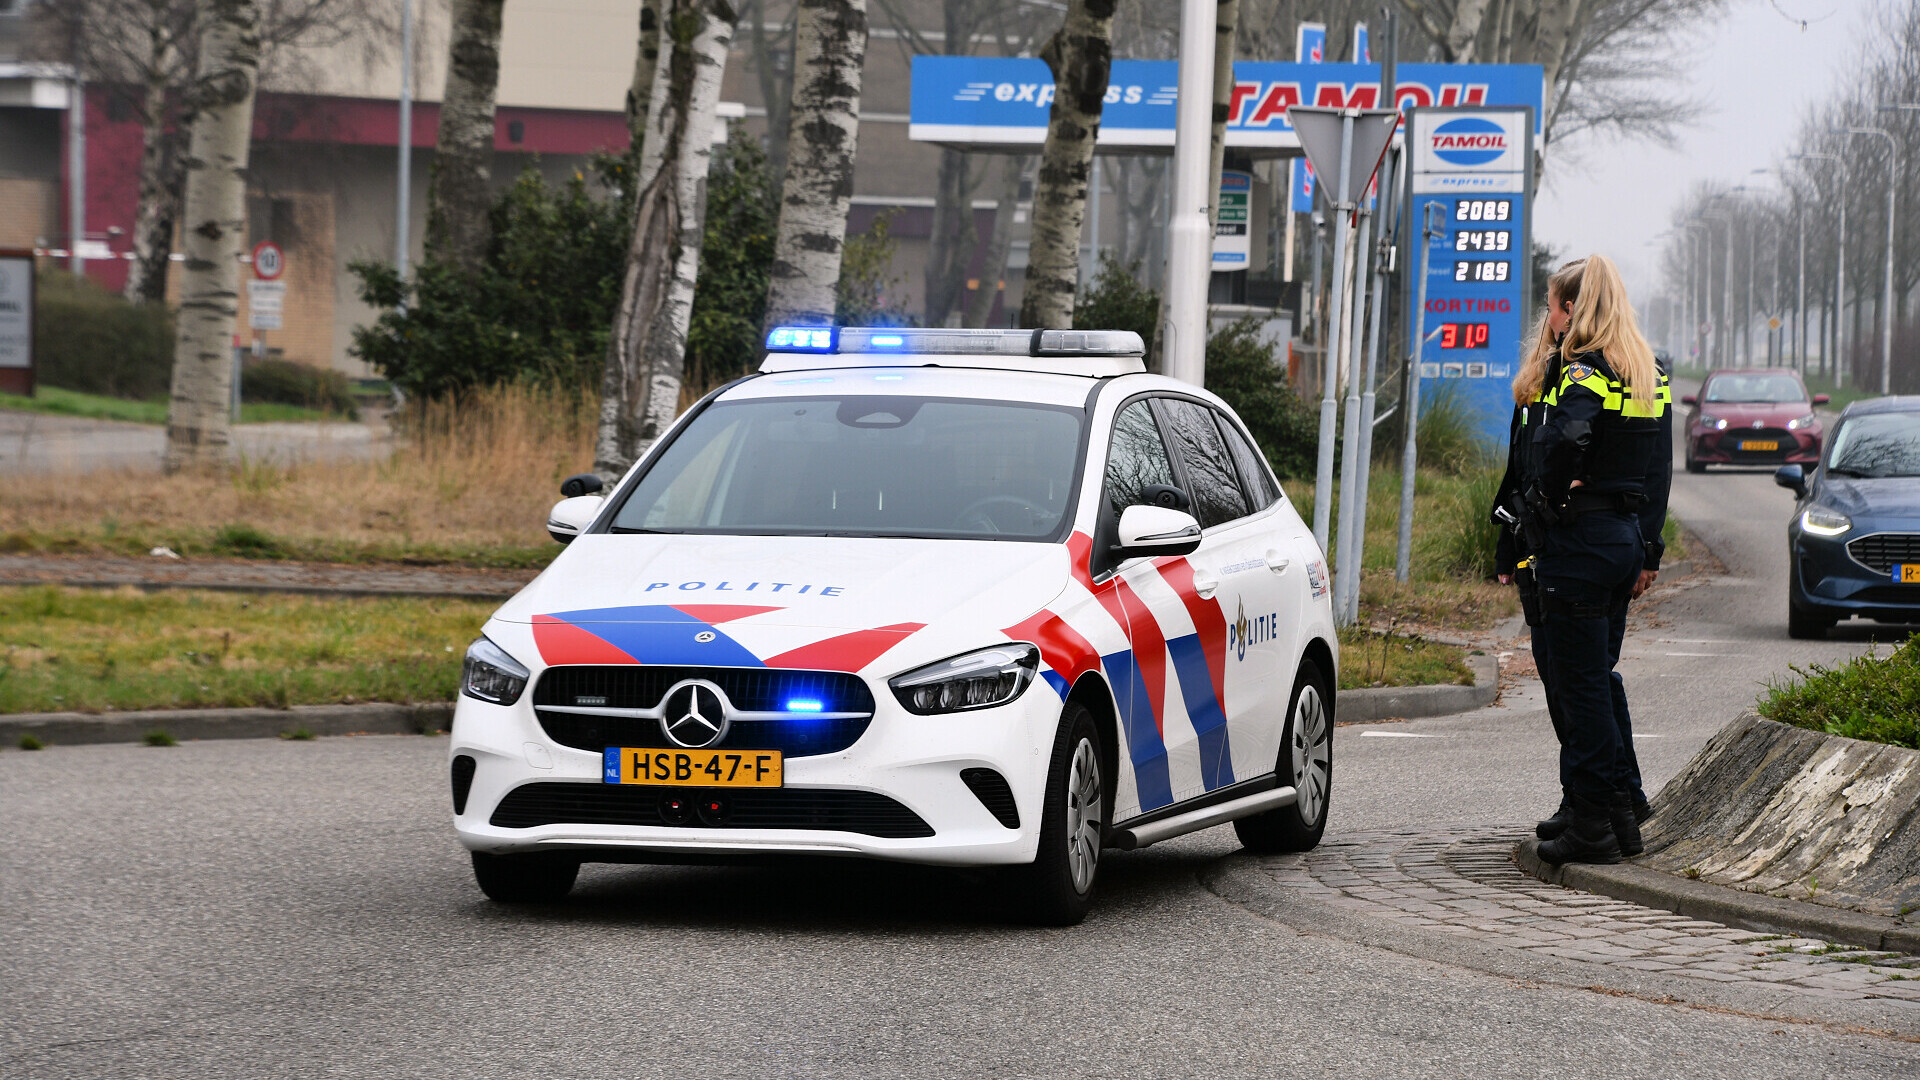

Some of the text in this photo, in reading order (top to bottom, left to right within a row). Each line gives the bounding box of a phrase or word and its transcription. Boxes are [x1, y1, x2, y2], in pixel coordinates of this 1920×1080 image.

[994, 82, 1143, 108] expss
[1432, 135, 1507, 148] TAMOIL
[1442, 178, 1494, 186] express
[1425, 298, 1510, 313] KORTING
[644, 581, 845, 597] POLITIE
[1230, 612, 1277, 661] POLITIE
[606, 769, 620, 778] NL
[633, 753, 772, 782] HSB-47-F
